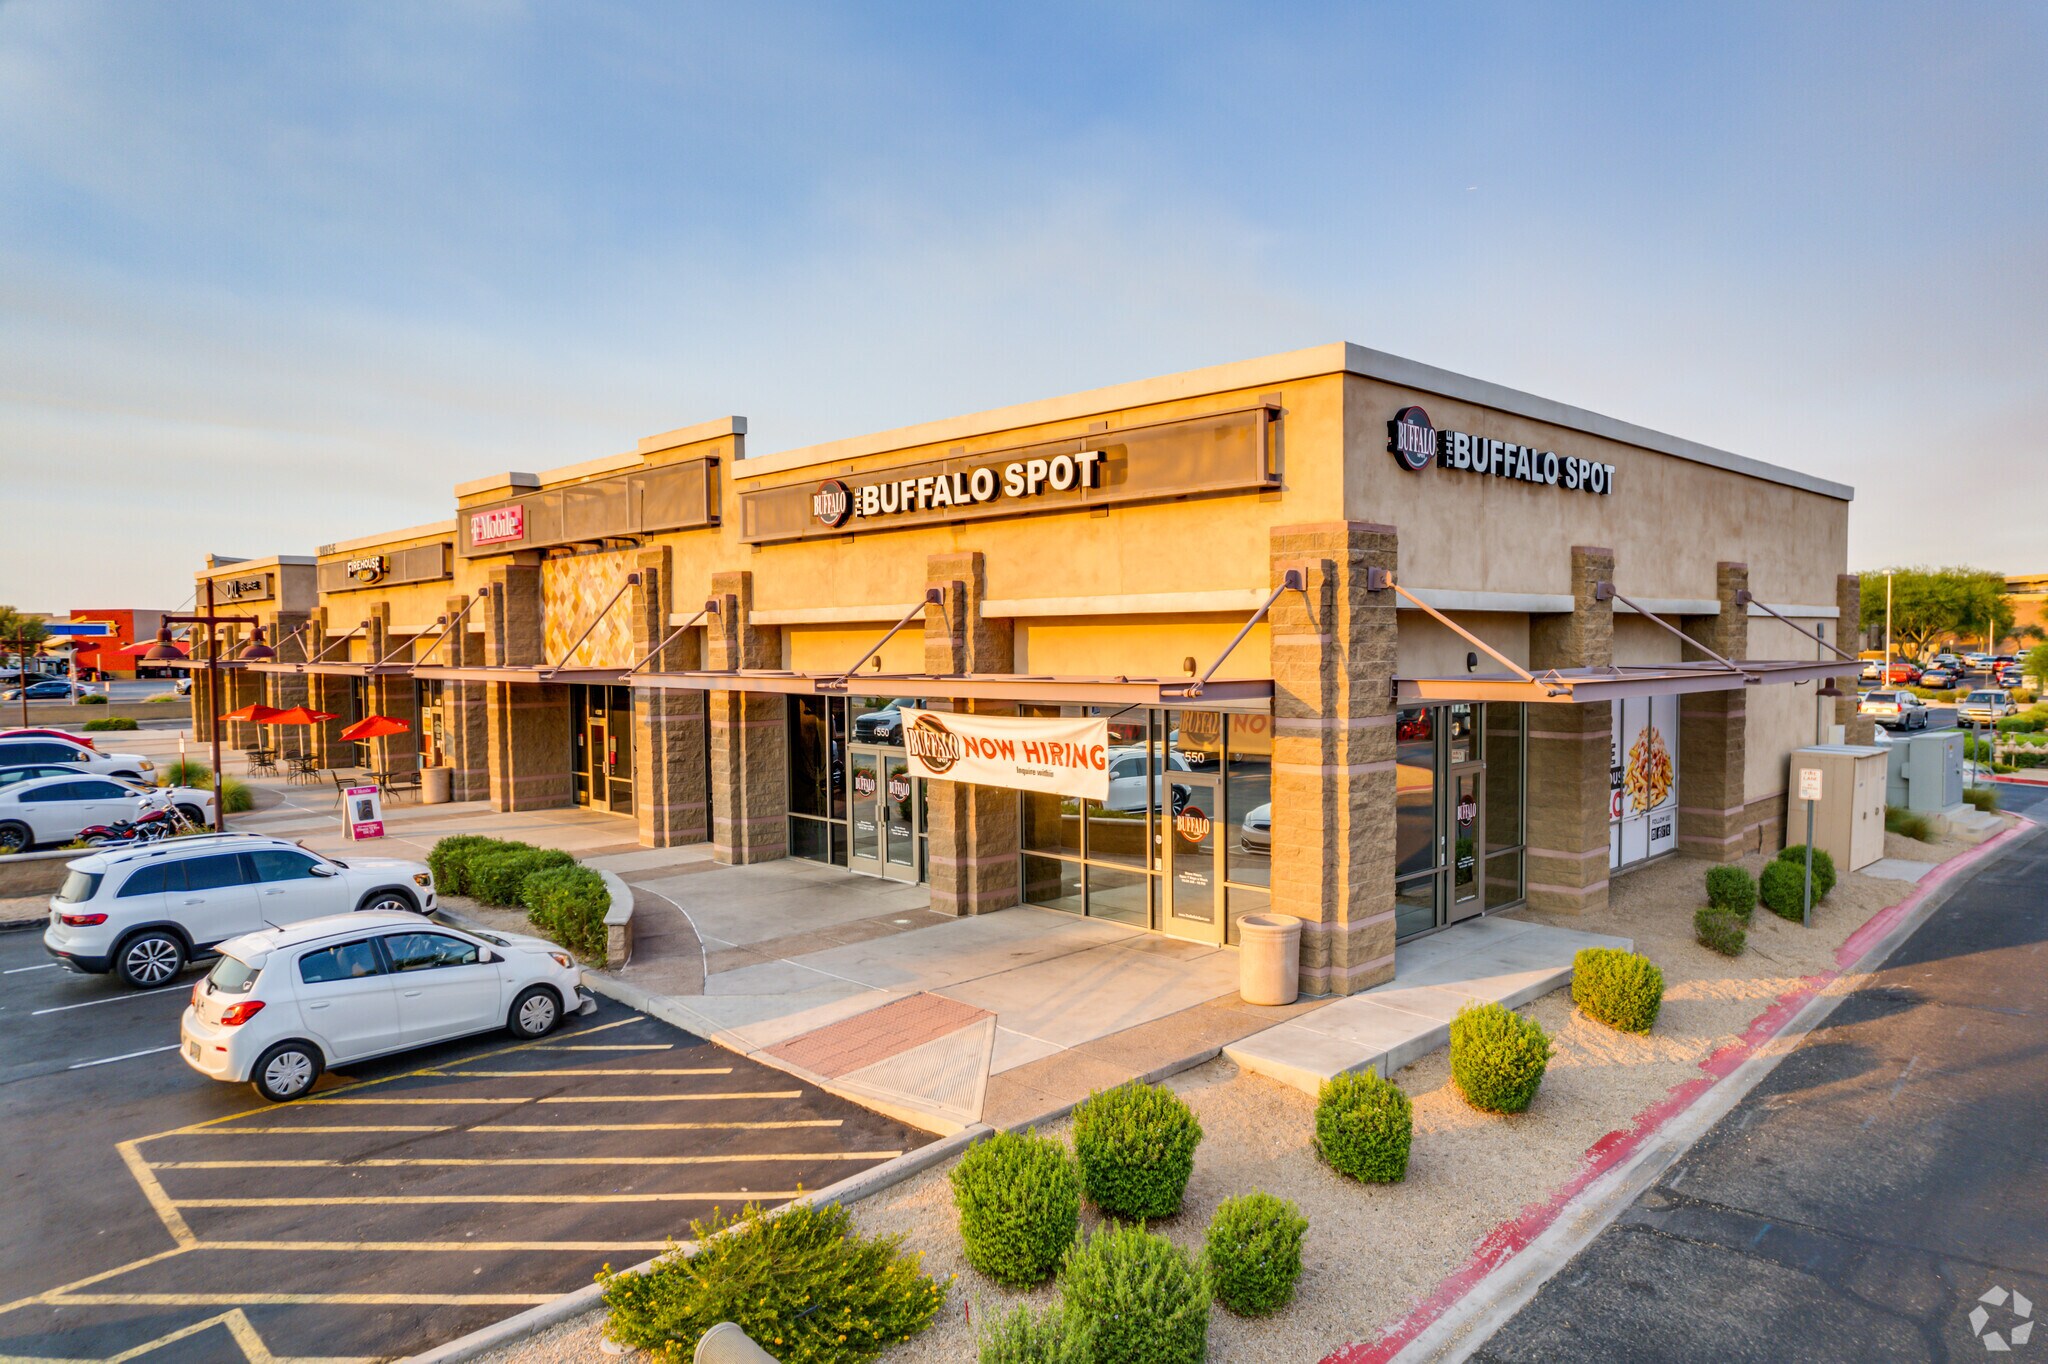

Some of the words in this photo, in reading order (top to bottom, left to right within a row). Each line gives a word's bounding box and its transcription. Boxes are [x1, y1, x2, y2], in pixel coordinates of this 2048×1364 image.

[1397, 420, 1437, 456] BUFFALO
[1446, 430, 1454, 468] THE
[1454, 431, 1559, 485] BUFFALO
[1565, 456, 1615, 495] SPOT
[855, 487, 863, 518] THE
[863, 467, 995, 516] BUFFALO
[1004, 450, 1099, 498] SPOT
[813, 491, 846, 517] BUFFALO
[471, 511, 516, 541] T-Mobile
[347, 556, 380, 578] FIREHOUSE
[907, 727, 961, 761] BUFFALO
[962, 735, 1016, 762] NOW
[1021, 740, 1106, 771] HIRING
[1184, 751, 1205, 764] 550
[1016, 766, 1036, 776] Inquire
[1037, 768, 1054, 778] within
[855, 776, 876, 793] BUFFALO
[889, 780, 910, 797] BUFFALO
[1457, 802, 1477, 821] BUFFALO
[1176, 814, 1210, 836] BUFFALO
